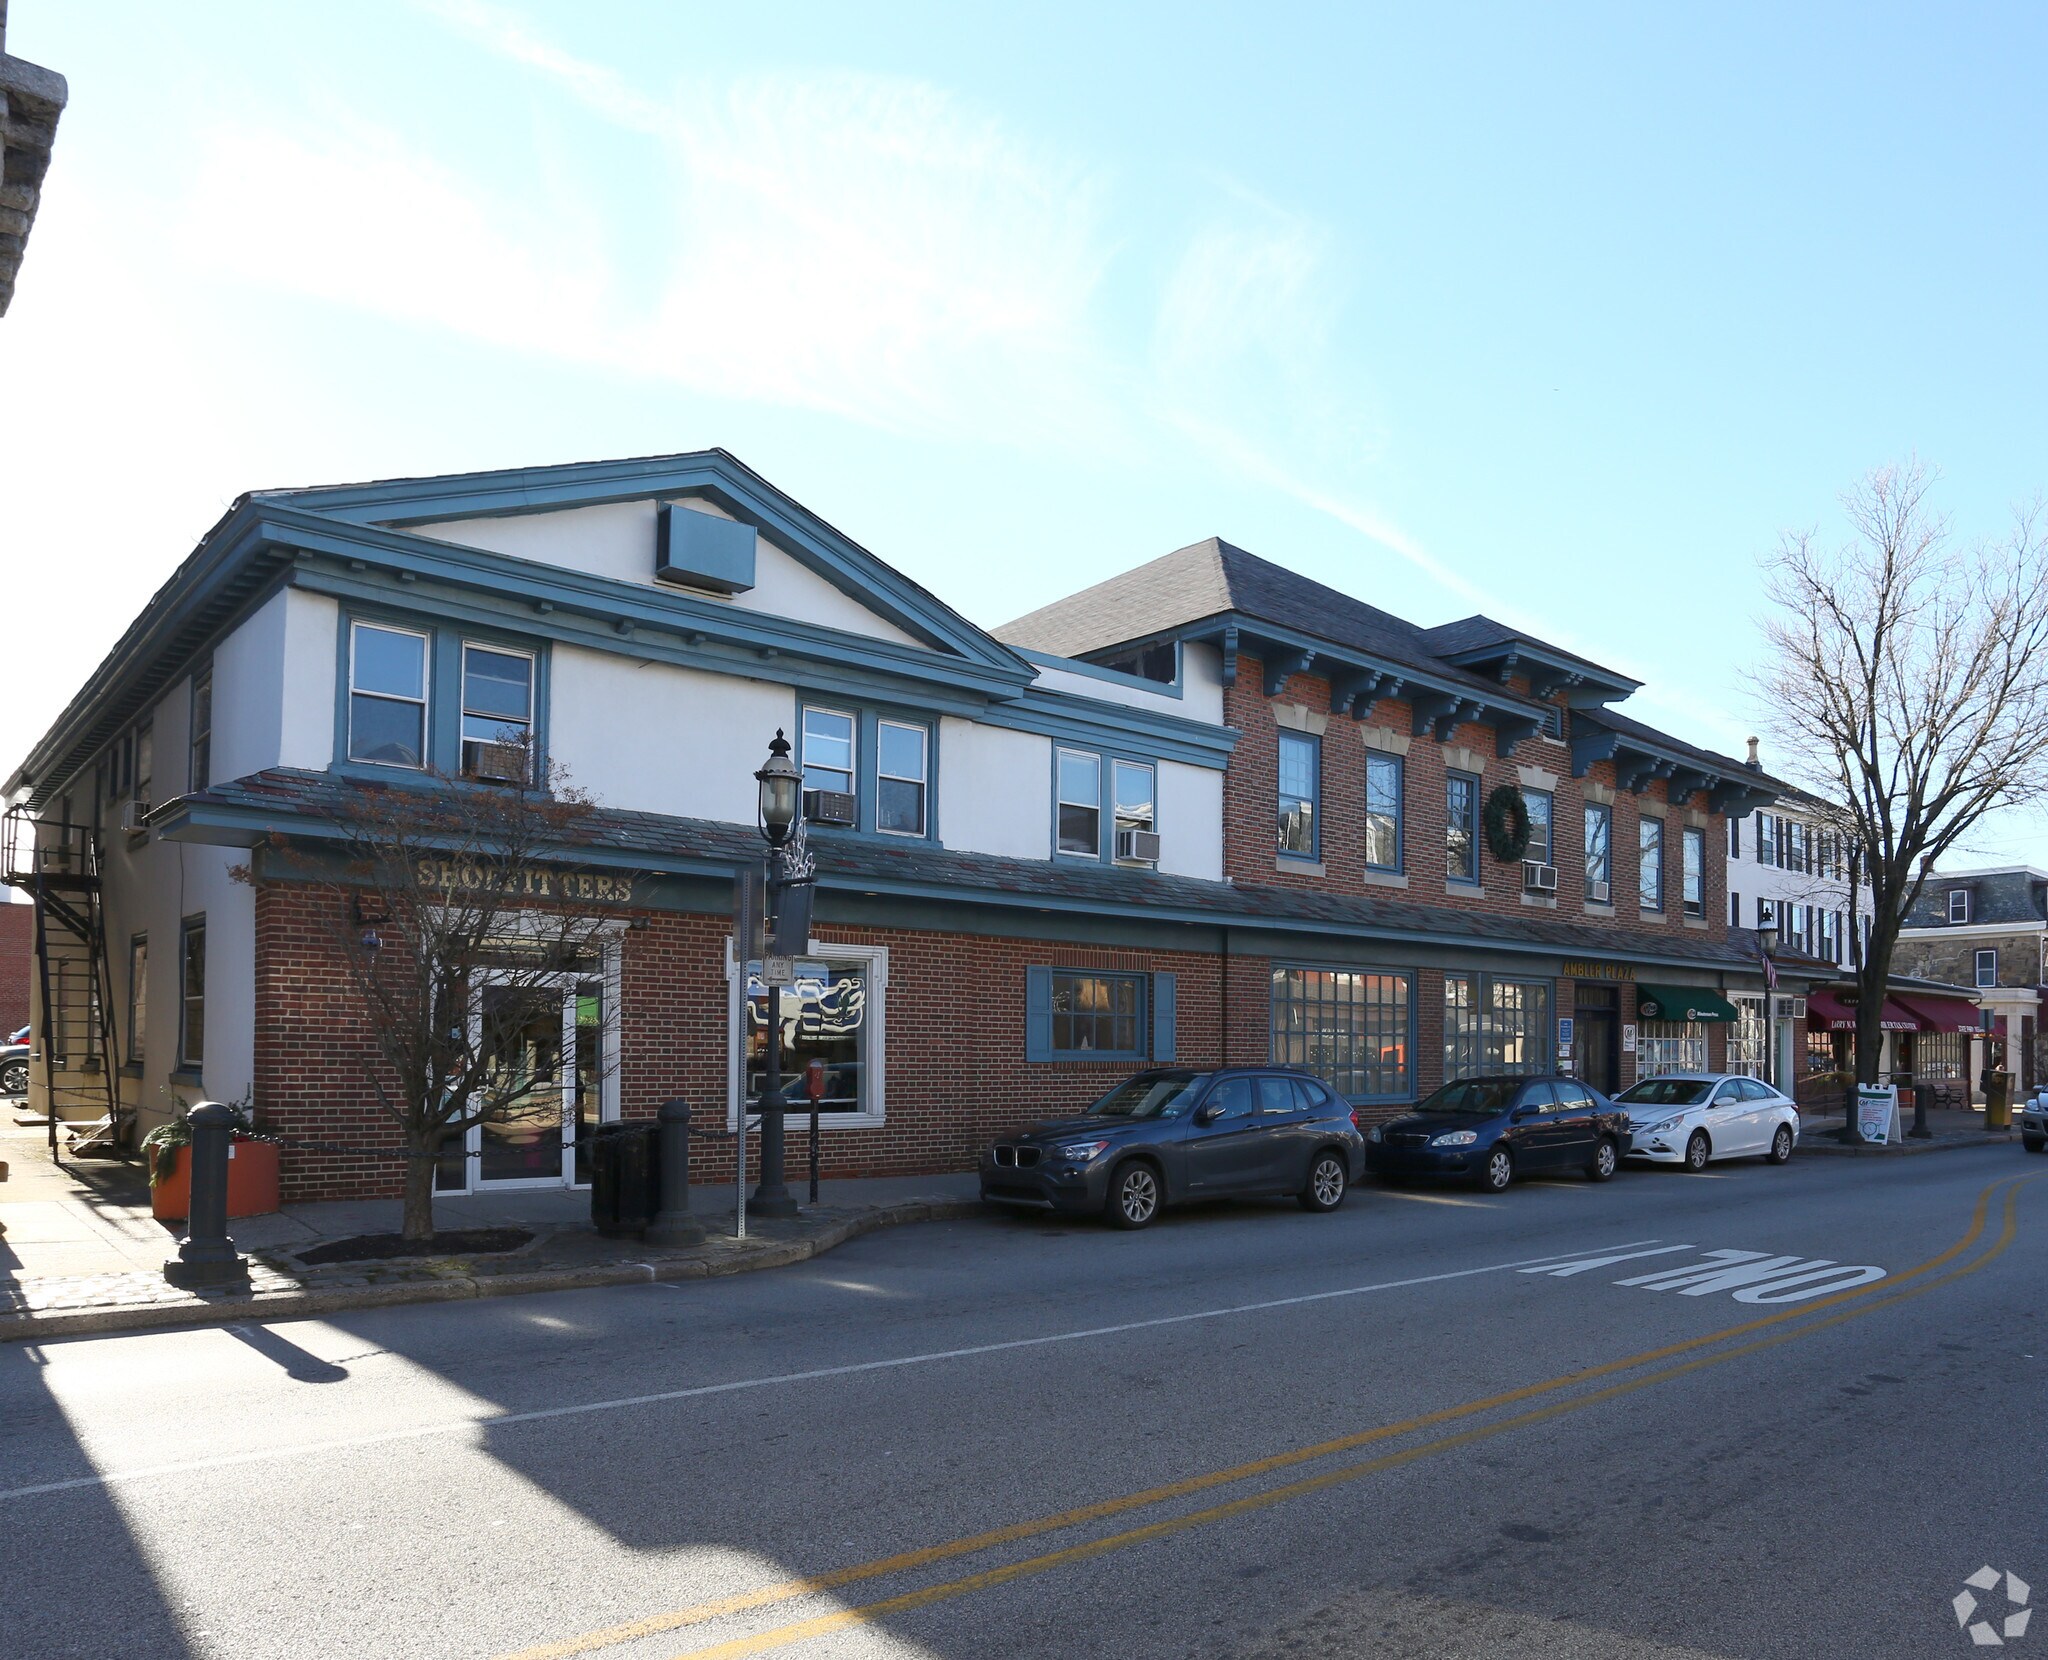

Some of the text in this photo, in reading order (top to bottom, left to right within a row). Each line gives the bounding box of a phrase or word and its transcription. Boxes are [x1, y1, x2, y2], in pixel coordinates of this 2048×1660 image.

[1563, 961, 1637, 980] AMBLER PLAZA
[1515, 1244, 1887, 1304] ONLY
